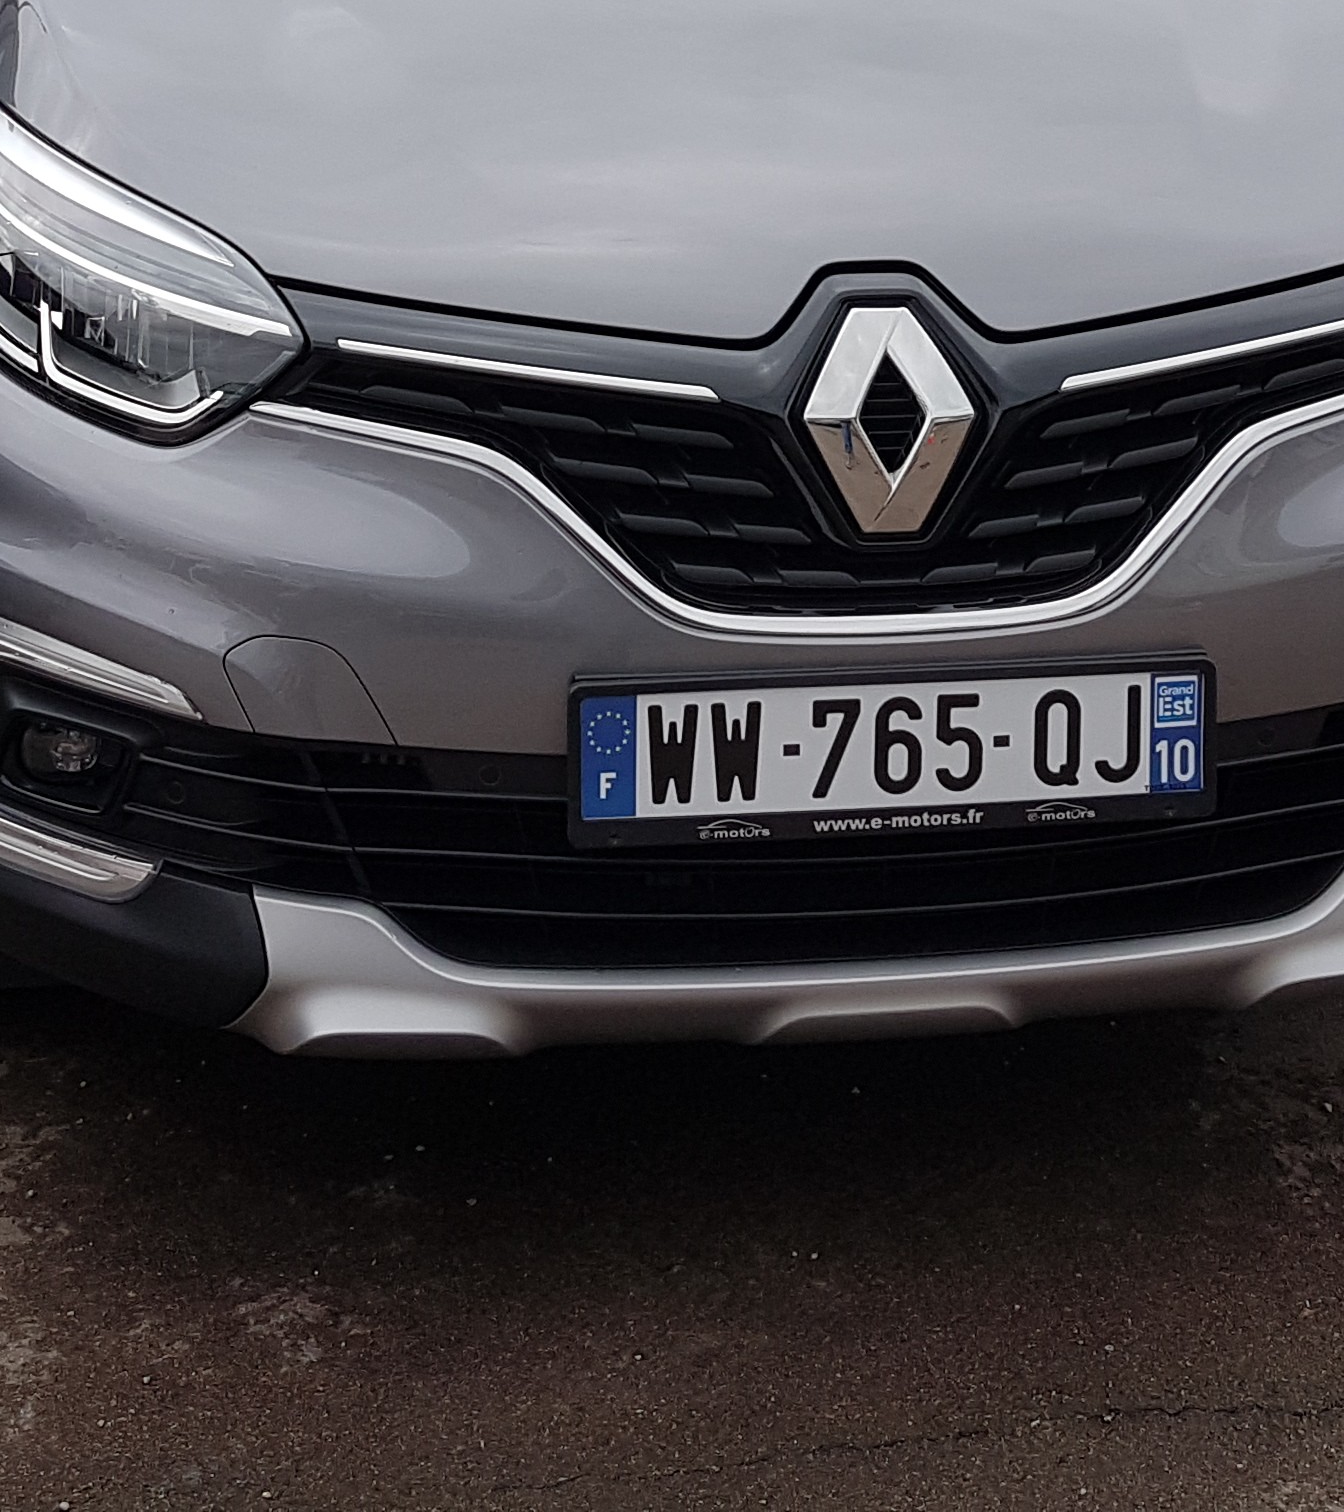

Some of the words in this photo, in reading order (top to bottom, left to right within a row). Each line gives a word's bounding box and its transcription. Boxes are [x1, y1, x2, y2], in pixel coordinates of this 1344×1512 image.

[1159, 683, 1194, 696] Grand
[1158, 696, 1193, 716] Est
[1155, 738, 1195, 784] 10
[599, 773, 616, 799] F
[813, 809, 984, 832] www.e-motors.fr
